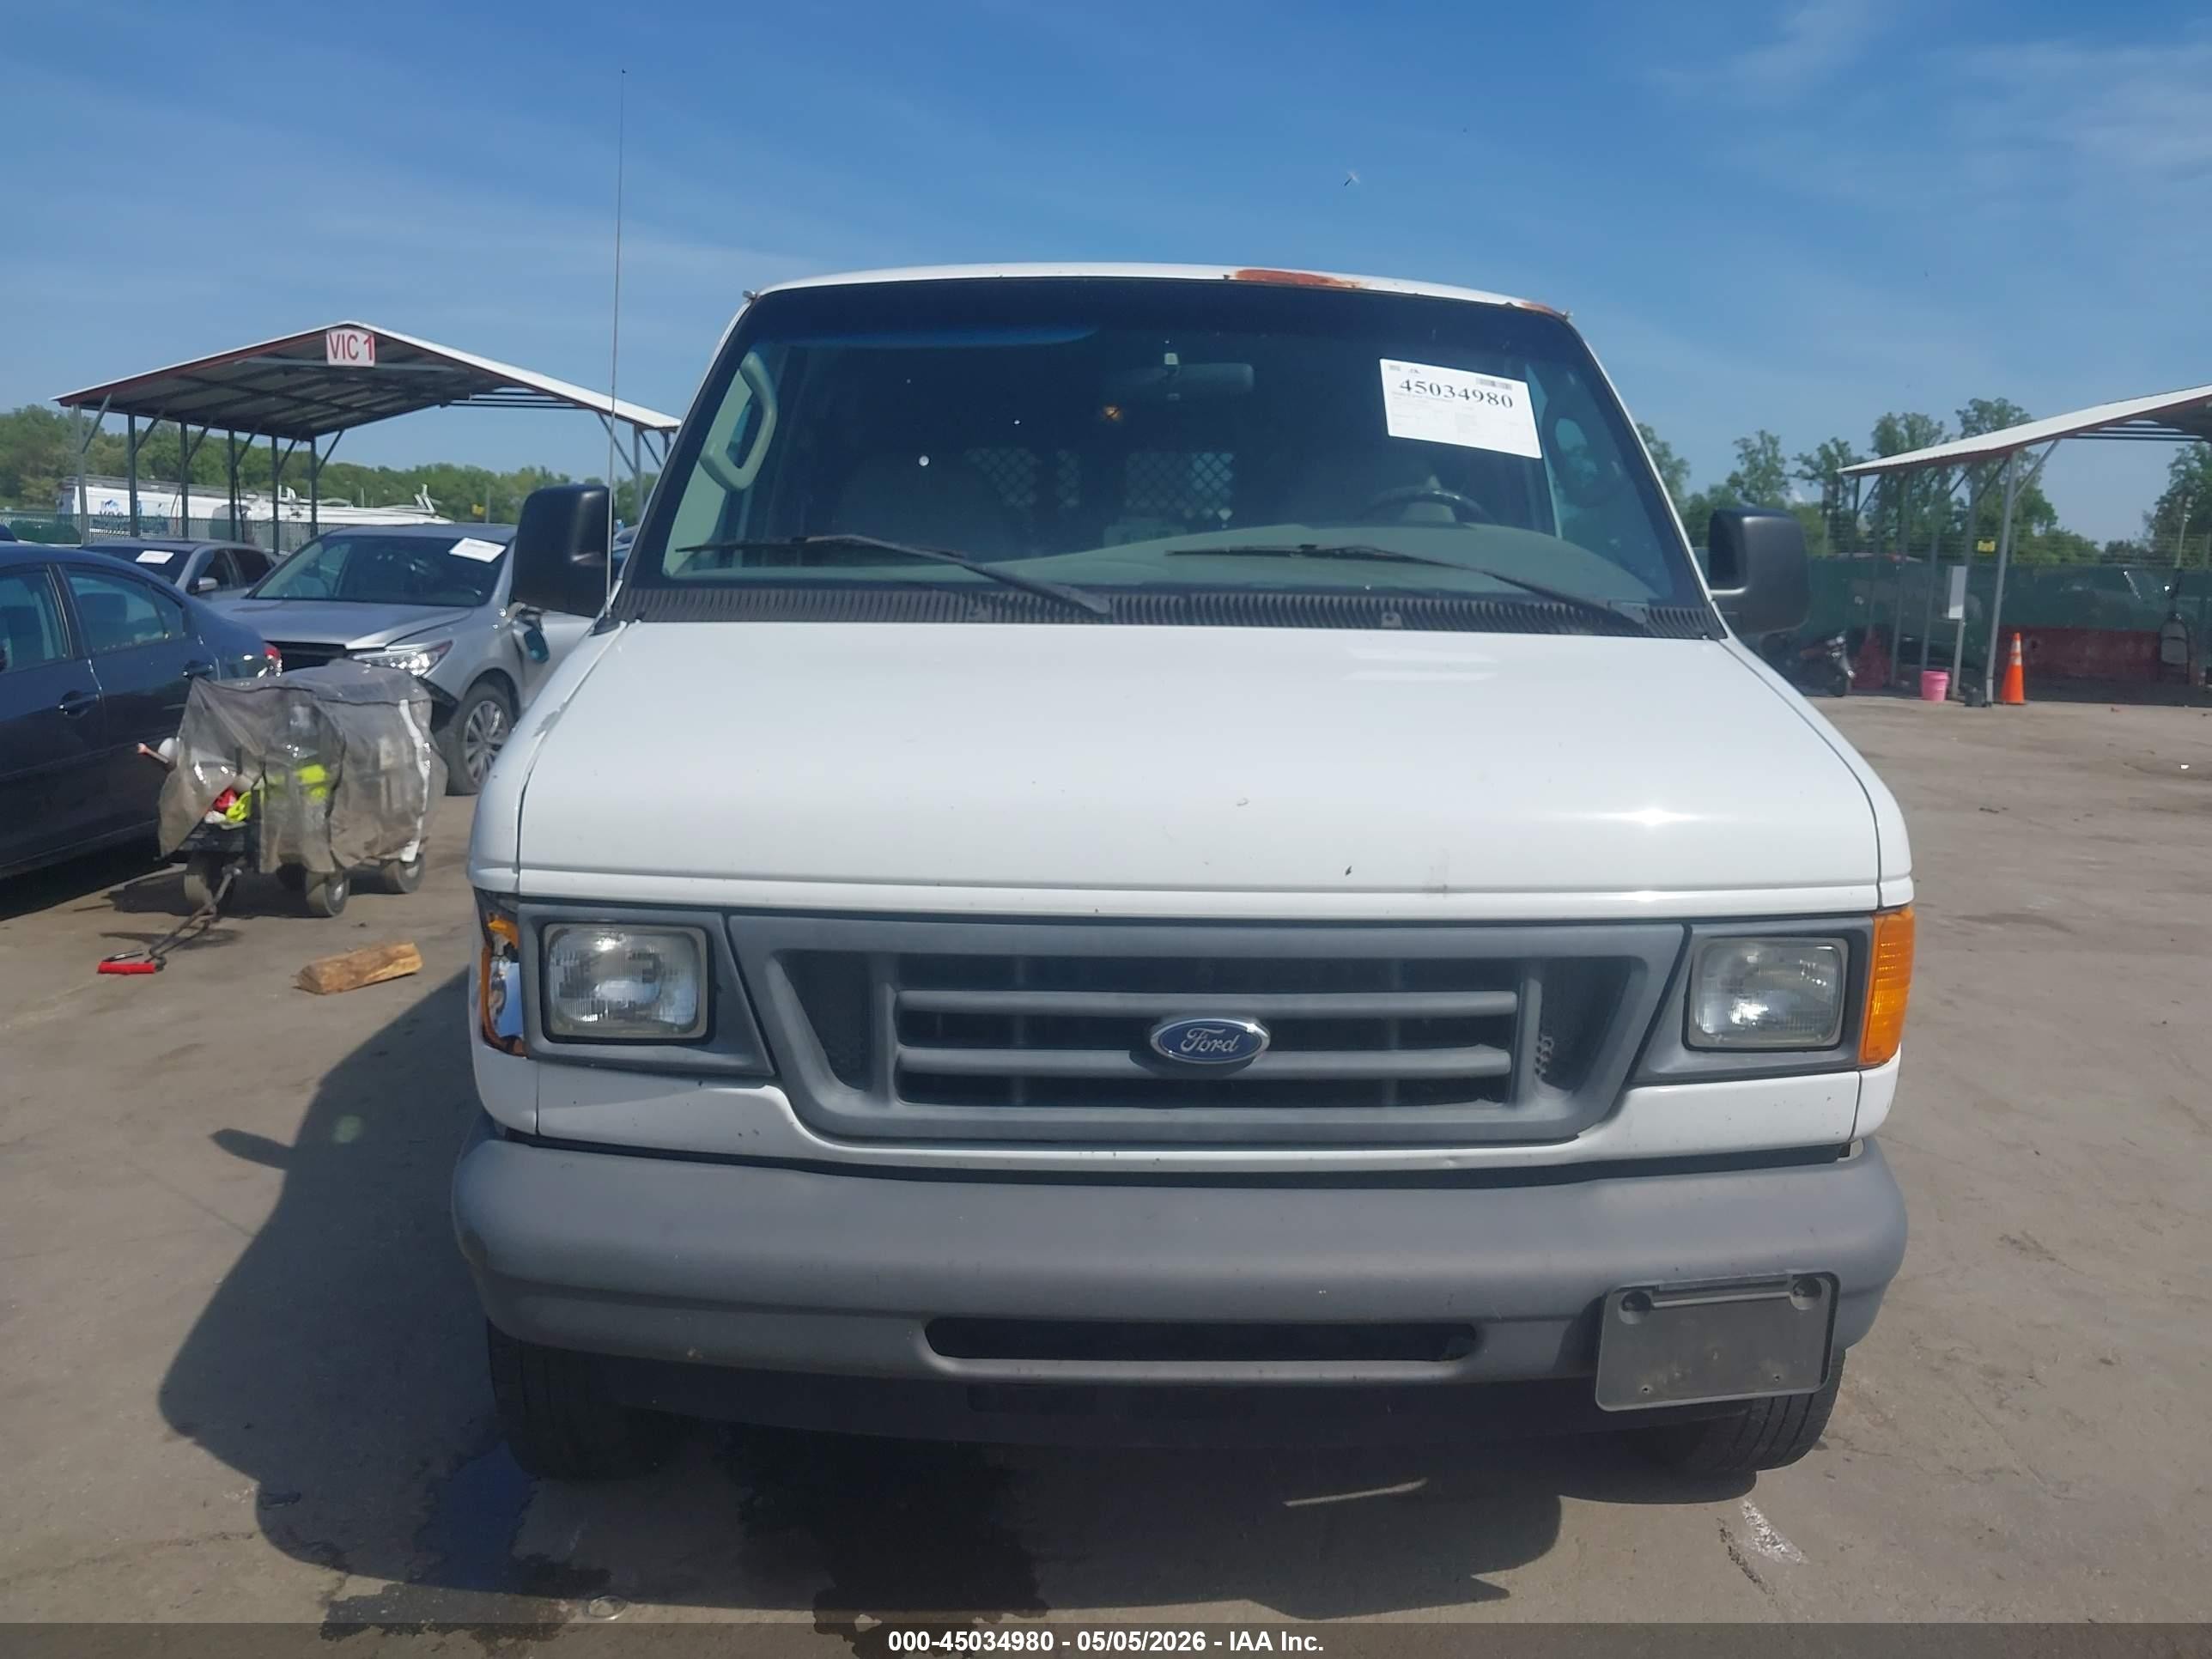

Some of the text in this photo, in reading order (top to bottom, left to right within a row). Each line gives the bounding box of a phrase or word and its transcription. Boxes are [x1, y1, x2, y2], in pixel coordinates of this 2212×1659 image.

[329, 333, 374, 361] VIC 1
[1400, 379, 1514, 408] 45034980
[1180, 1027, 1240, 1053] Ford
